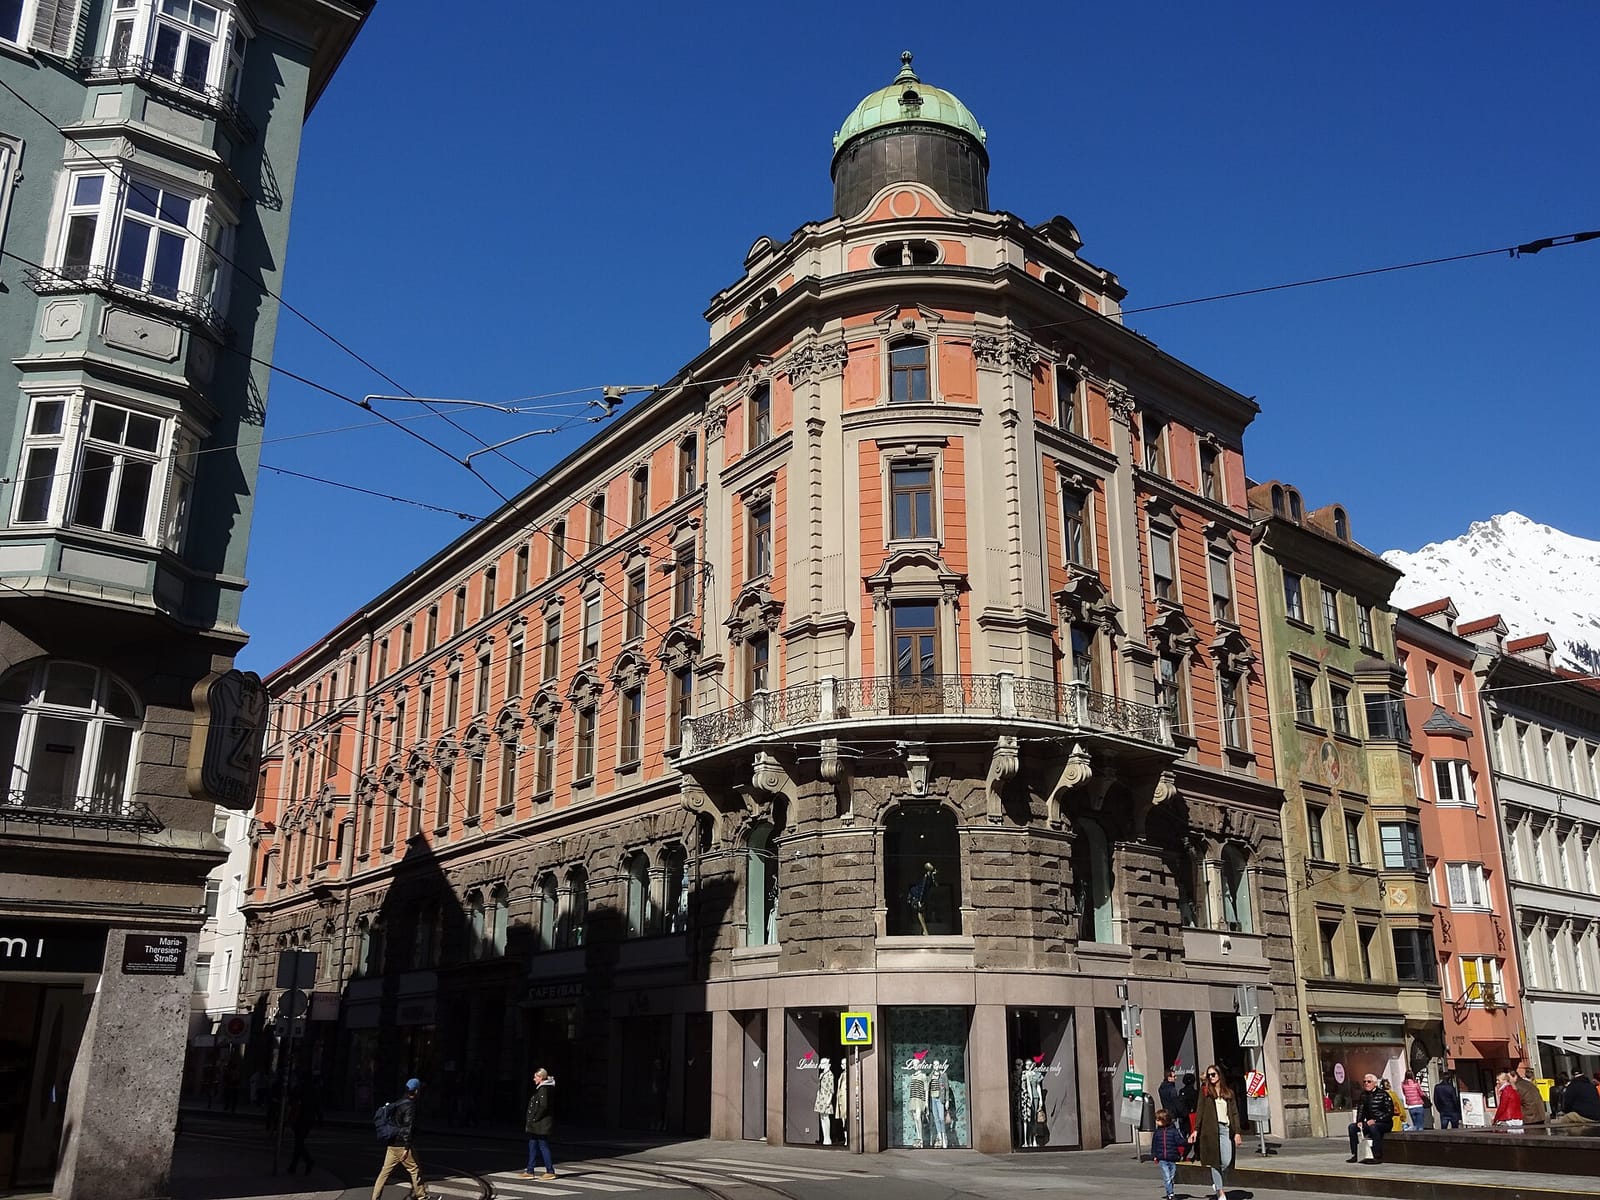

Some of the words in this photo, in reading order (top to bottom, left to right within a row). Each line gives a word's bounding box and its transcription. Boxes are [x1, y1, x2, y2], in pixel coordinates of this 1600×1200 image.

[159, 937, 183, 946] Maria-
[144, 945, 182, 954] Theresien-
[153, 954, 178, 963] Straße
